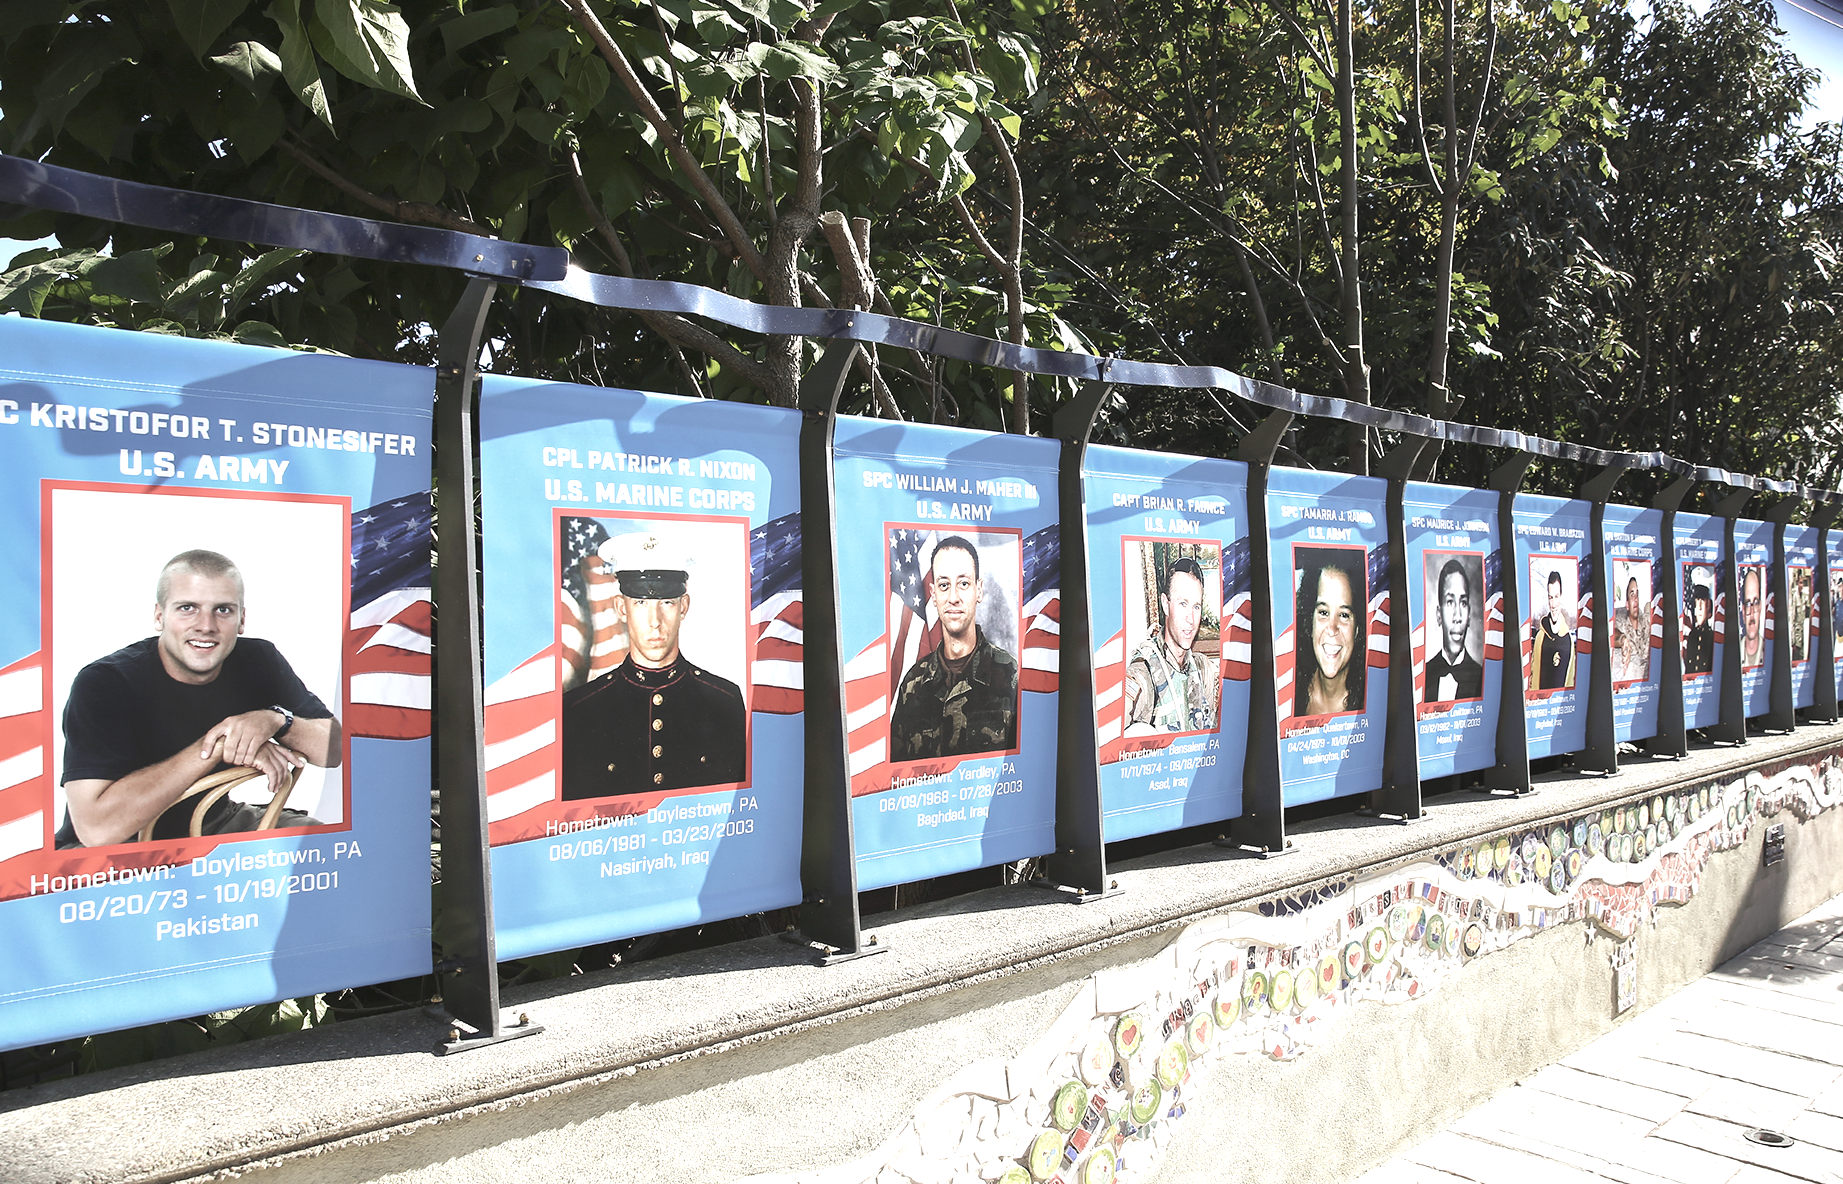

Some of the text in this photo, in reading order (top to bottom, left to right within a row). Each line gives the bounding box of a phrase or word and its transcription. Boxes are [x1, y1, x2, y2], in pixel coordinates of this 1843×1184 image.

[30, 402, 210, 441] KRISTOFOR
[219, 418, 243, 443] T.
[252, 422, 417, 457] STONESIFER
[119, 448, 290, 485] U.S. ARMY
[542, 446, 756, 482] CPL PATRICK R. NIXON
[544, 478, 756, 512] U.S. MARINE CORPS
[862, 470, 1037, 500] SPC WILLIAM J. MAHER III
[916, 500, 993, 522] U.S. ARMY
[1112, 492, 1141, 508] CAPT
[1142, 495, 1175, 511] BRIAN
[1176, 498, 1187, 512] R.
[1280, 505, 1298, 519] SPC
[1299, 507, 1338, 521] TAMARRA
[1338, 510, 1346, 522] J.
[1144, 516, 1200, 535] U.S. ARMY
[1308, 526, 1352, 541] U.S. ARMY
[1411, 516, 1426, 528] SPC
[1426, 518, 1455, 531] MAURICE
[1455, 520, 1462, 531] J.
[1436, 534, 1471, 548] U.S. ARMY
[1539, 541, 1567, 553] U.S. ARMY
[1285, 725, 1320, 738] Hometown:
[1360, 718, 1369, 729] PA
[1118, 738, 1221, 762] Hometown: Bensalem, PA
[1302, 749, 1351, 765] Washington, DC
[891, 762, 1016, 791] Hometown: Yardley, PA
[1120, 762, 1162, 779] 11/11/1974
[1169, 755, 1217, 772] 09/18/2003
[879, 789, 950, 813] 06/09/1968
[959, 779, 1023, 802] 07/28/2003
[1148, 776, 1189, 792] Asad, Iraq
[545, 796, 759, 837] Hometown: Doylestown, PA
[917, 805, 990, 828] Baghdad, Iraq
[549, 833, 647, 862] 08/06/1981
[662, 818, 755, 846] 03/23/2003
[30, 840, 363, 896] Hometown: Doylestown, PA
[600, 850, 710, 878] Nasiriyah, Iraq
[59, 888, 188, 925] 08/20/73
[214, 871, 340, 905] 10/19/2001
[156, 912, 260, 941] Pakistan
